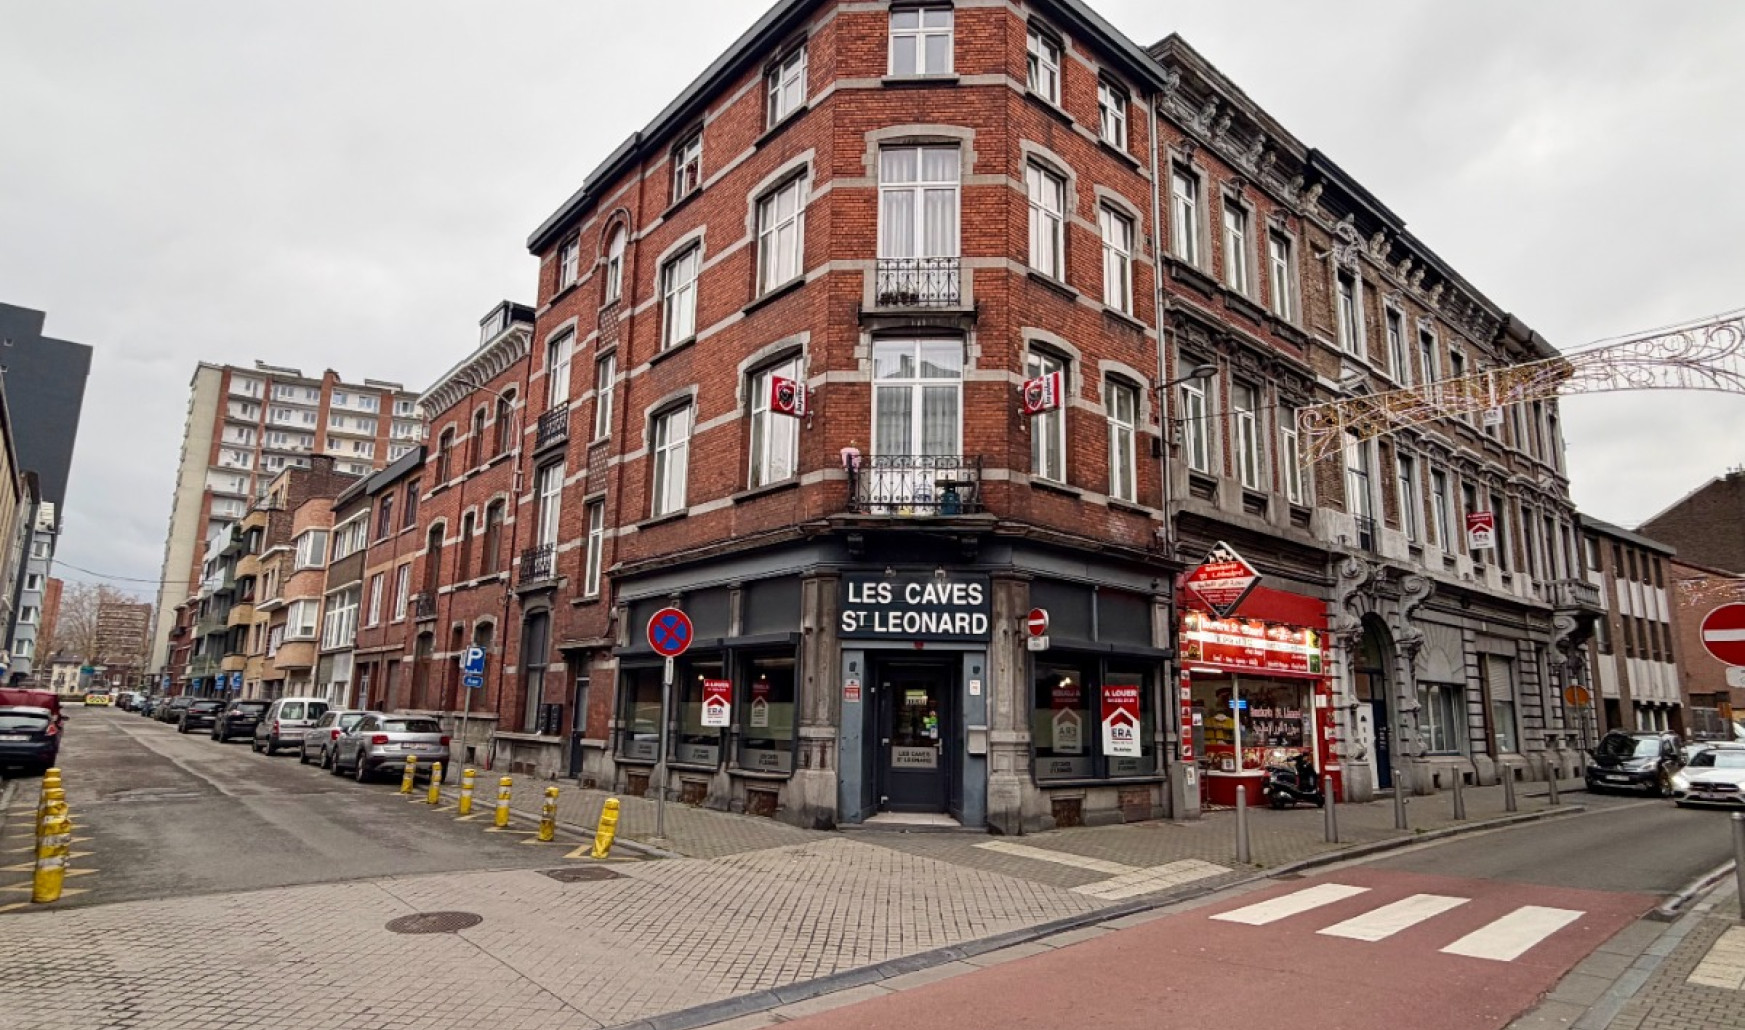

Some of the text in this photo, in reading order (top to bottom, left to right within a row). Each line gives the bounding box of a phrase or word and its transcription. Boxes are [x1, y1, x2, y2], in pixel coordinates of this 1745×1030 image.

[848, 582, 984, 605] LES CAVES
[873, 611, 988, 635] LEONARD
[467, 648, 483, 666] P
[1104, 689, 1138, 697] A LOUER
[1111, 728, 1133, 738] ERA
